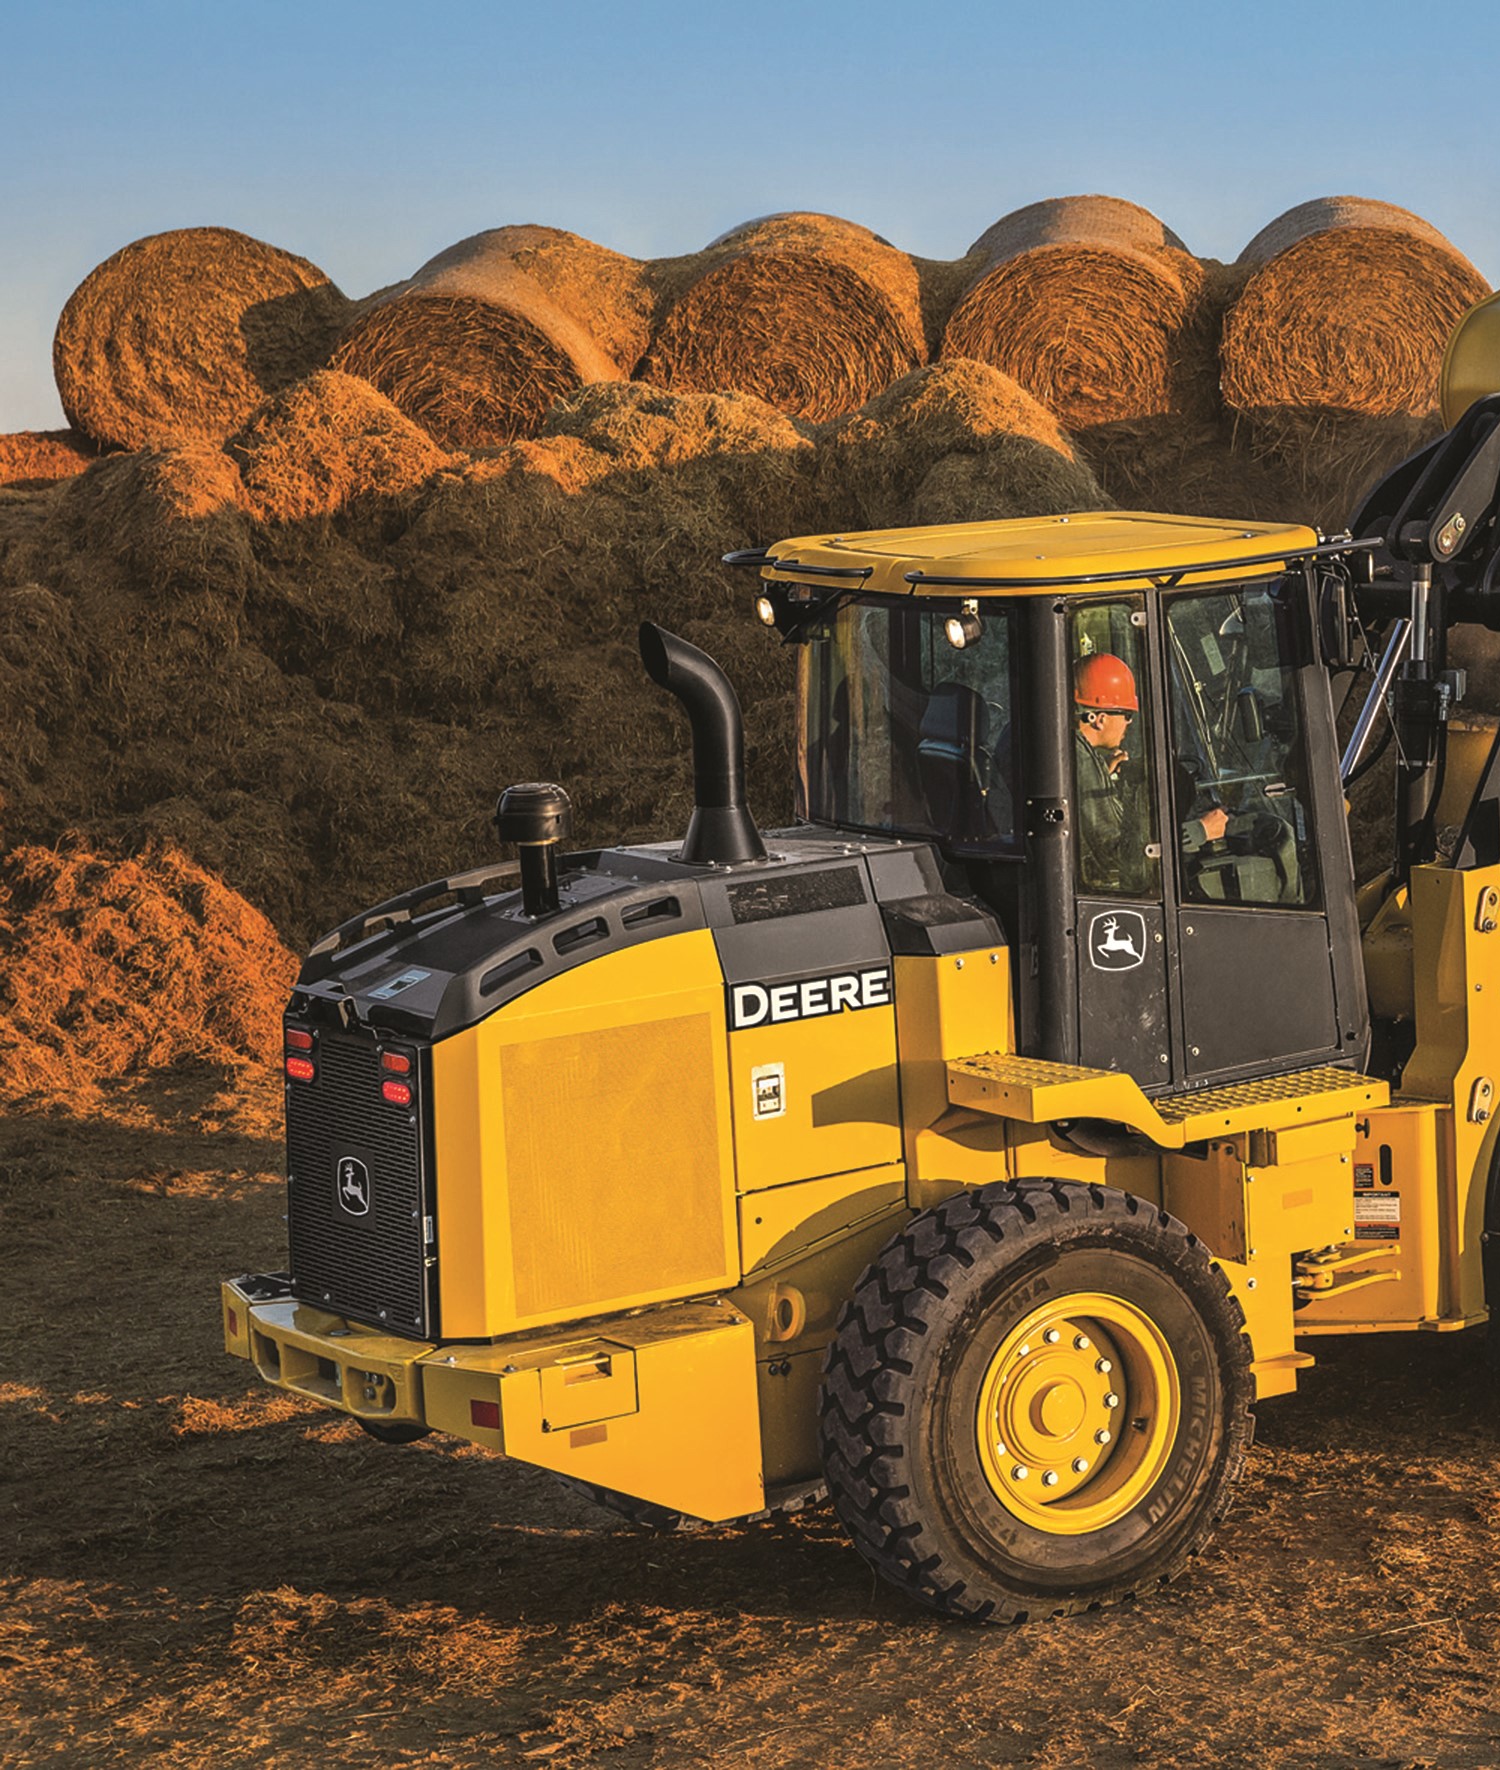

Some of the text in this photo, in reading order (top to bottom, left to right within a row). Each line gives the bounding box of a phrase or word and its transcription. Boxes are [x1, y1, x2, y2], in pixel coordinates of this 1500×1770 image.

[732, 969, 890, 1028] DEERE
[996, 1276, 1051, 1324] XHA
[1148, 1376, 1207, 1524] MICHELIN
